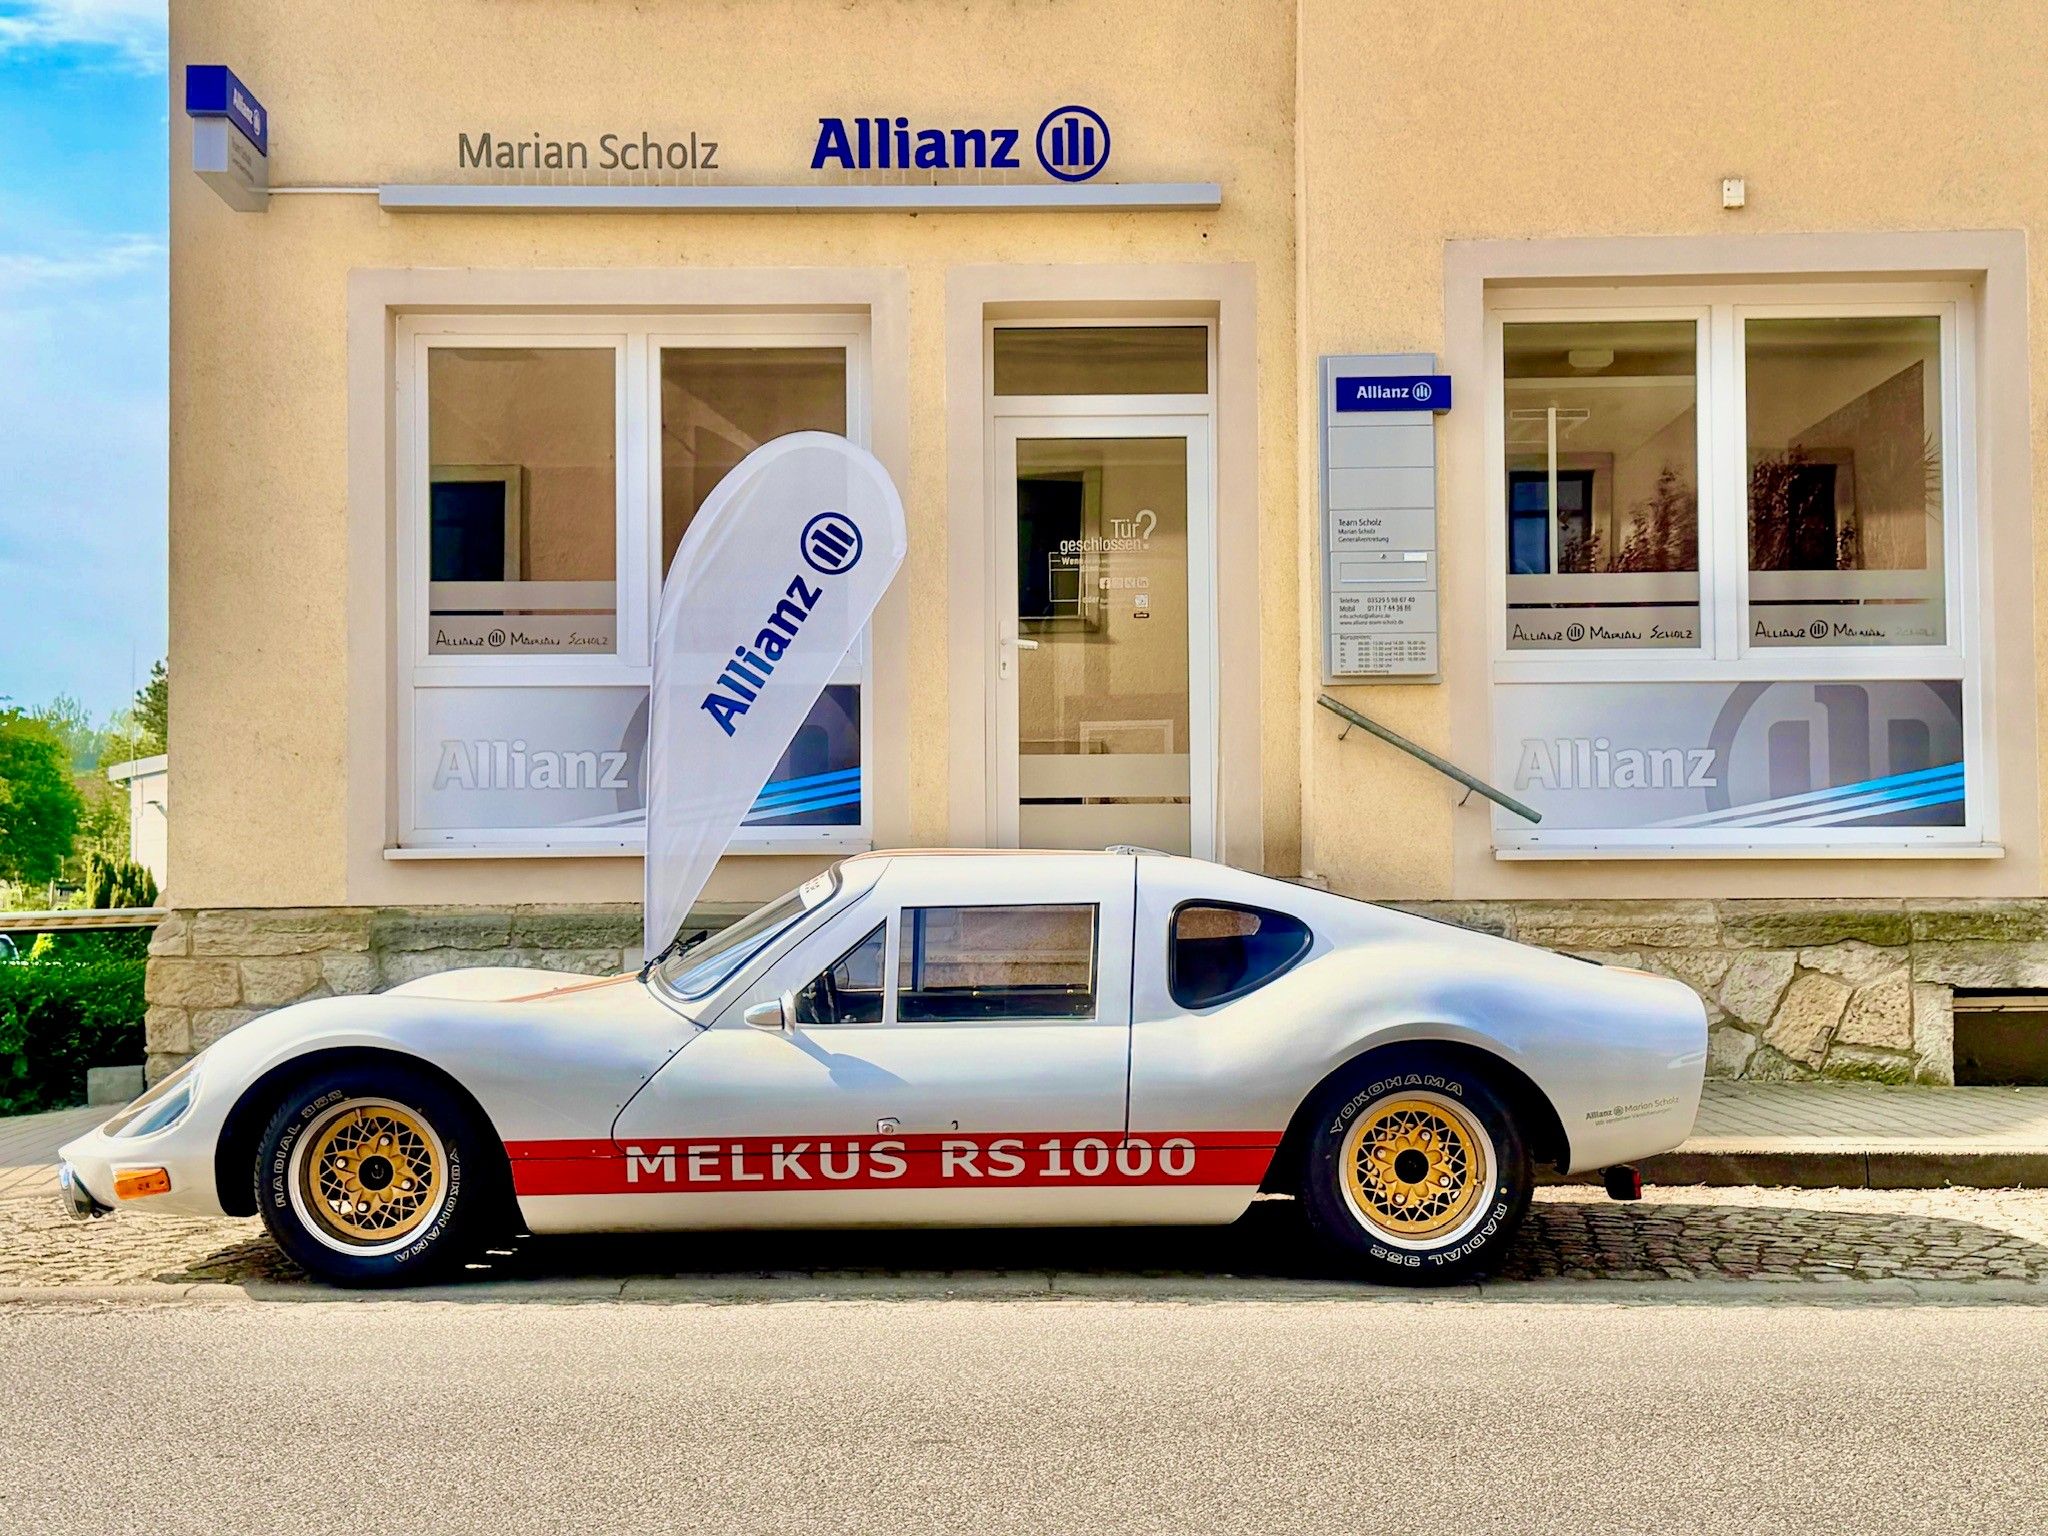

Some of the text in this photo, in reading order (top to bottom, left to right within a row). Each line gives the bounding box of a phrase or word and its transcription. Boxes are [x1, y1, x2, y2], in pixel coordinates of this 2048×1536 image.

[458, 131, 719, 170] Marian Scholz
[810, 117, 1020, 169] Allianz
[1356, 385, 1410, 399] Allianz
[1339, 518, 1382, 527] Team Scholz
[701, 574, 824, 738] Allianz
[433, 739, 629, 791] Allianz
[1514, 737, 1718, 790] Allianz
[1330, 1074, 1463, 1134] YOKOHAMA
[1585, 1109, 1613, 1120] Allianz
[1654, 1096, 1680, 1108] Scholz
[273, 1123, 301, 1208] RADIAL
[625, 1140, 908, 1183] MELKUS
[394, 1147, 461, 1263] YOKOHAMA
[1370, 1203, 1508, 1267] RADIAL 352
